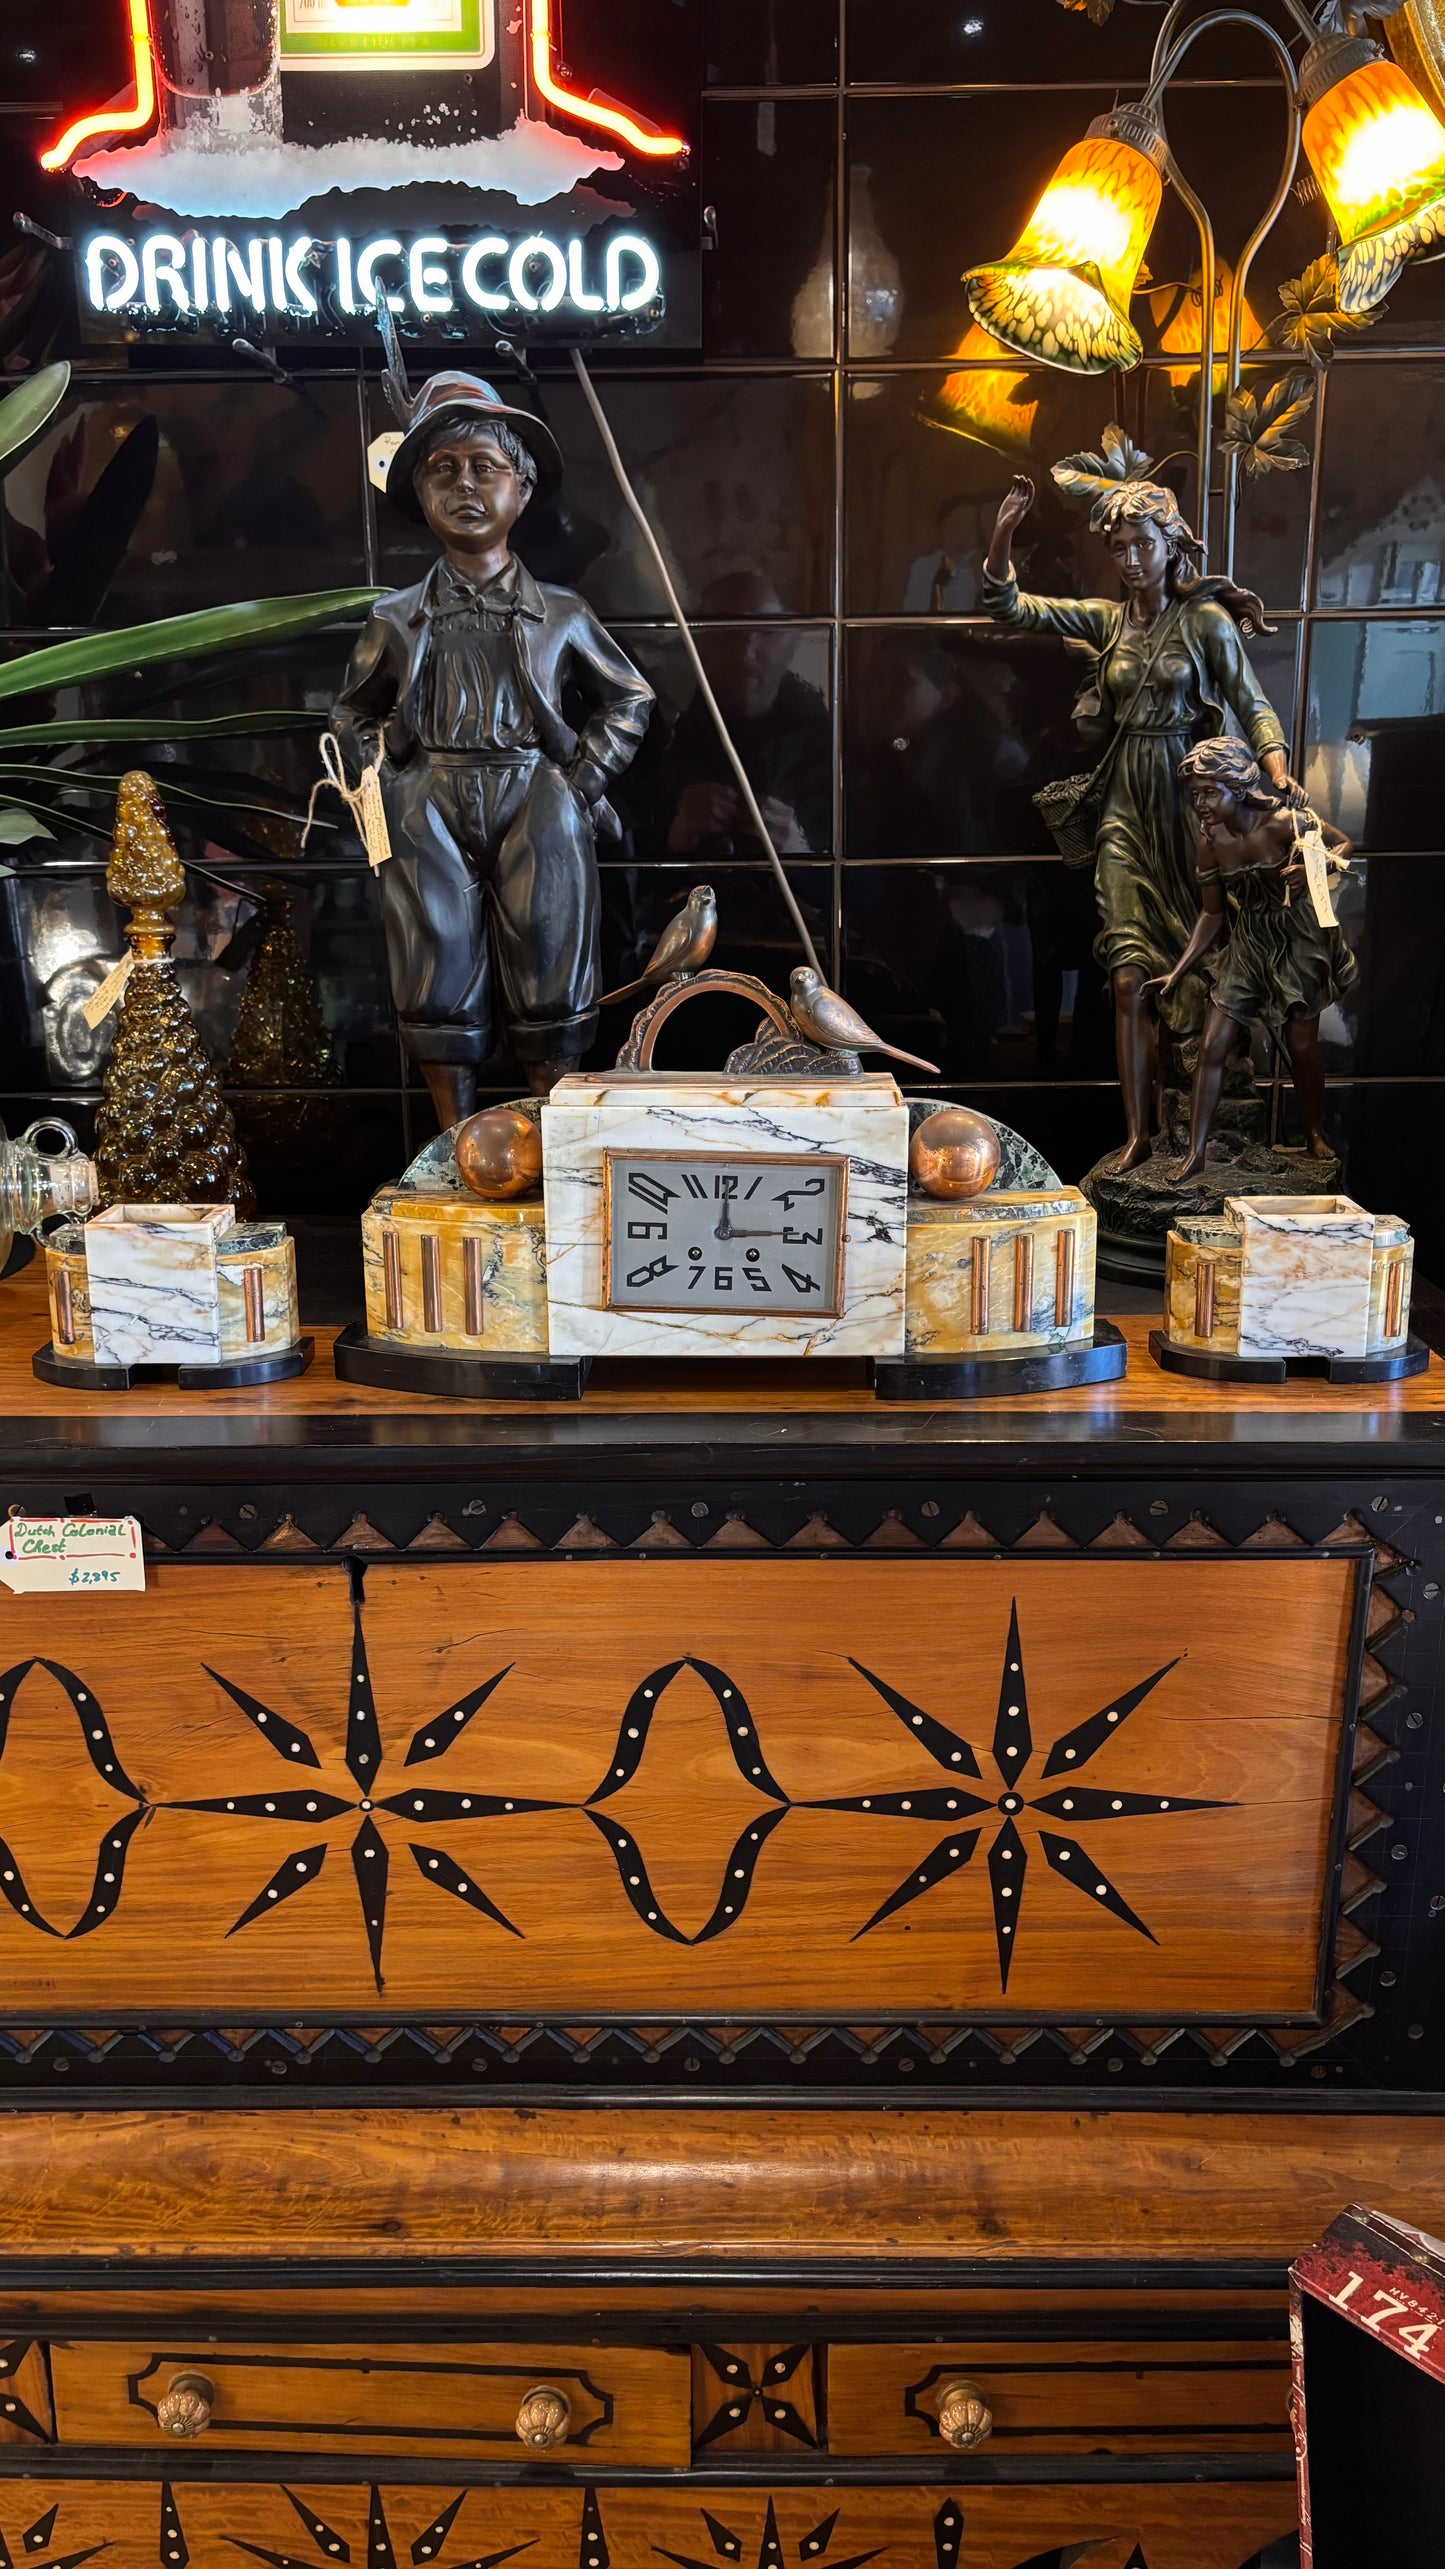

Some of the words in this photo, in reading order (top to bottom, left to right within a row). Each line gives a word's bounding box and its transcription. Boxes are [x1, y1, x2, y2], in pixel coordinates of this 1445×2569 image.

[86, 234, 319, 315] DRINK
[336, 236, 453, 314] ICE
[462, 234, 659, 312] COLD
[714, 1175, 738, 1199] 12
[771, 1178, 825, 1212] 2
[782, 1226, 823, 1245] 3
[626, 1254, 680, 1288] 8
[687, 1265, 707, 1290] 7
[714, 1266, 733, 1290] 6
[741, 1267, 772, 1292] 5
[781, 1263, 821, 1293] 4
[14, 1522, 56, 1537] Dutch
[22, 1538, 67, 1554] Chest
[1328, 2271, 1438, 2360] 174
